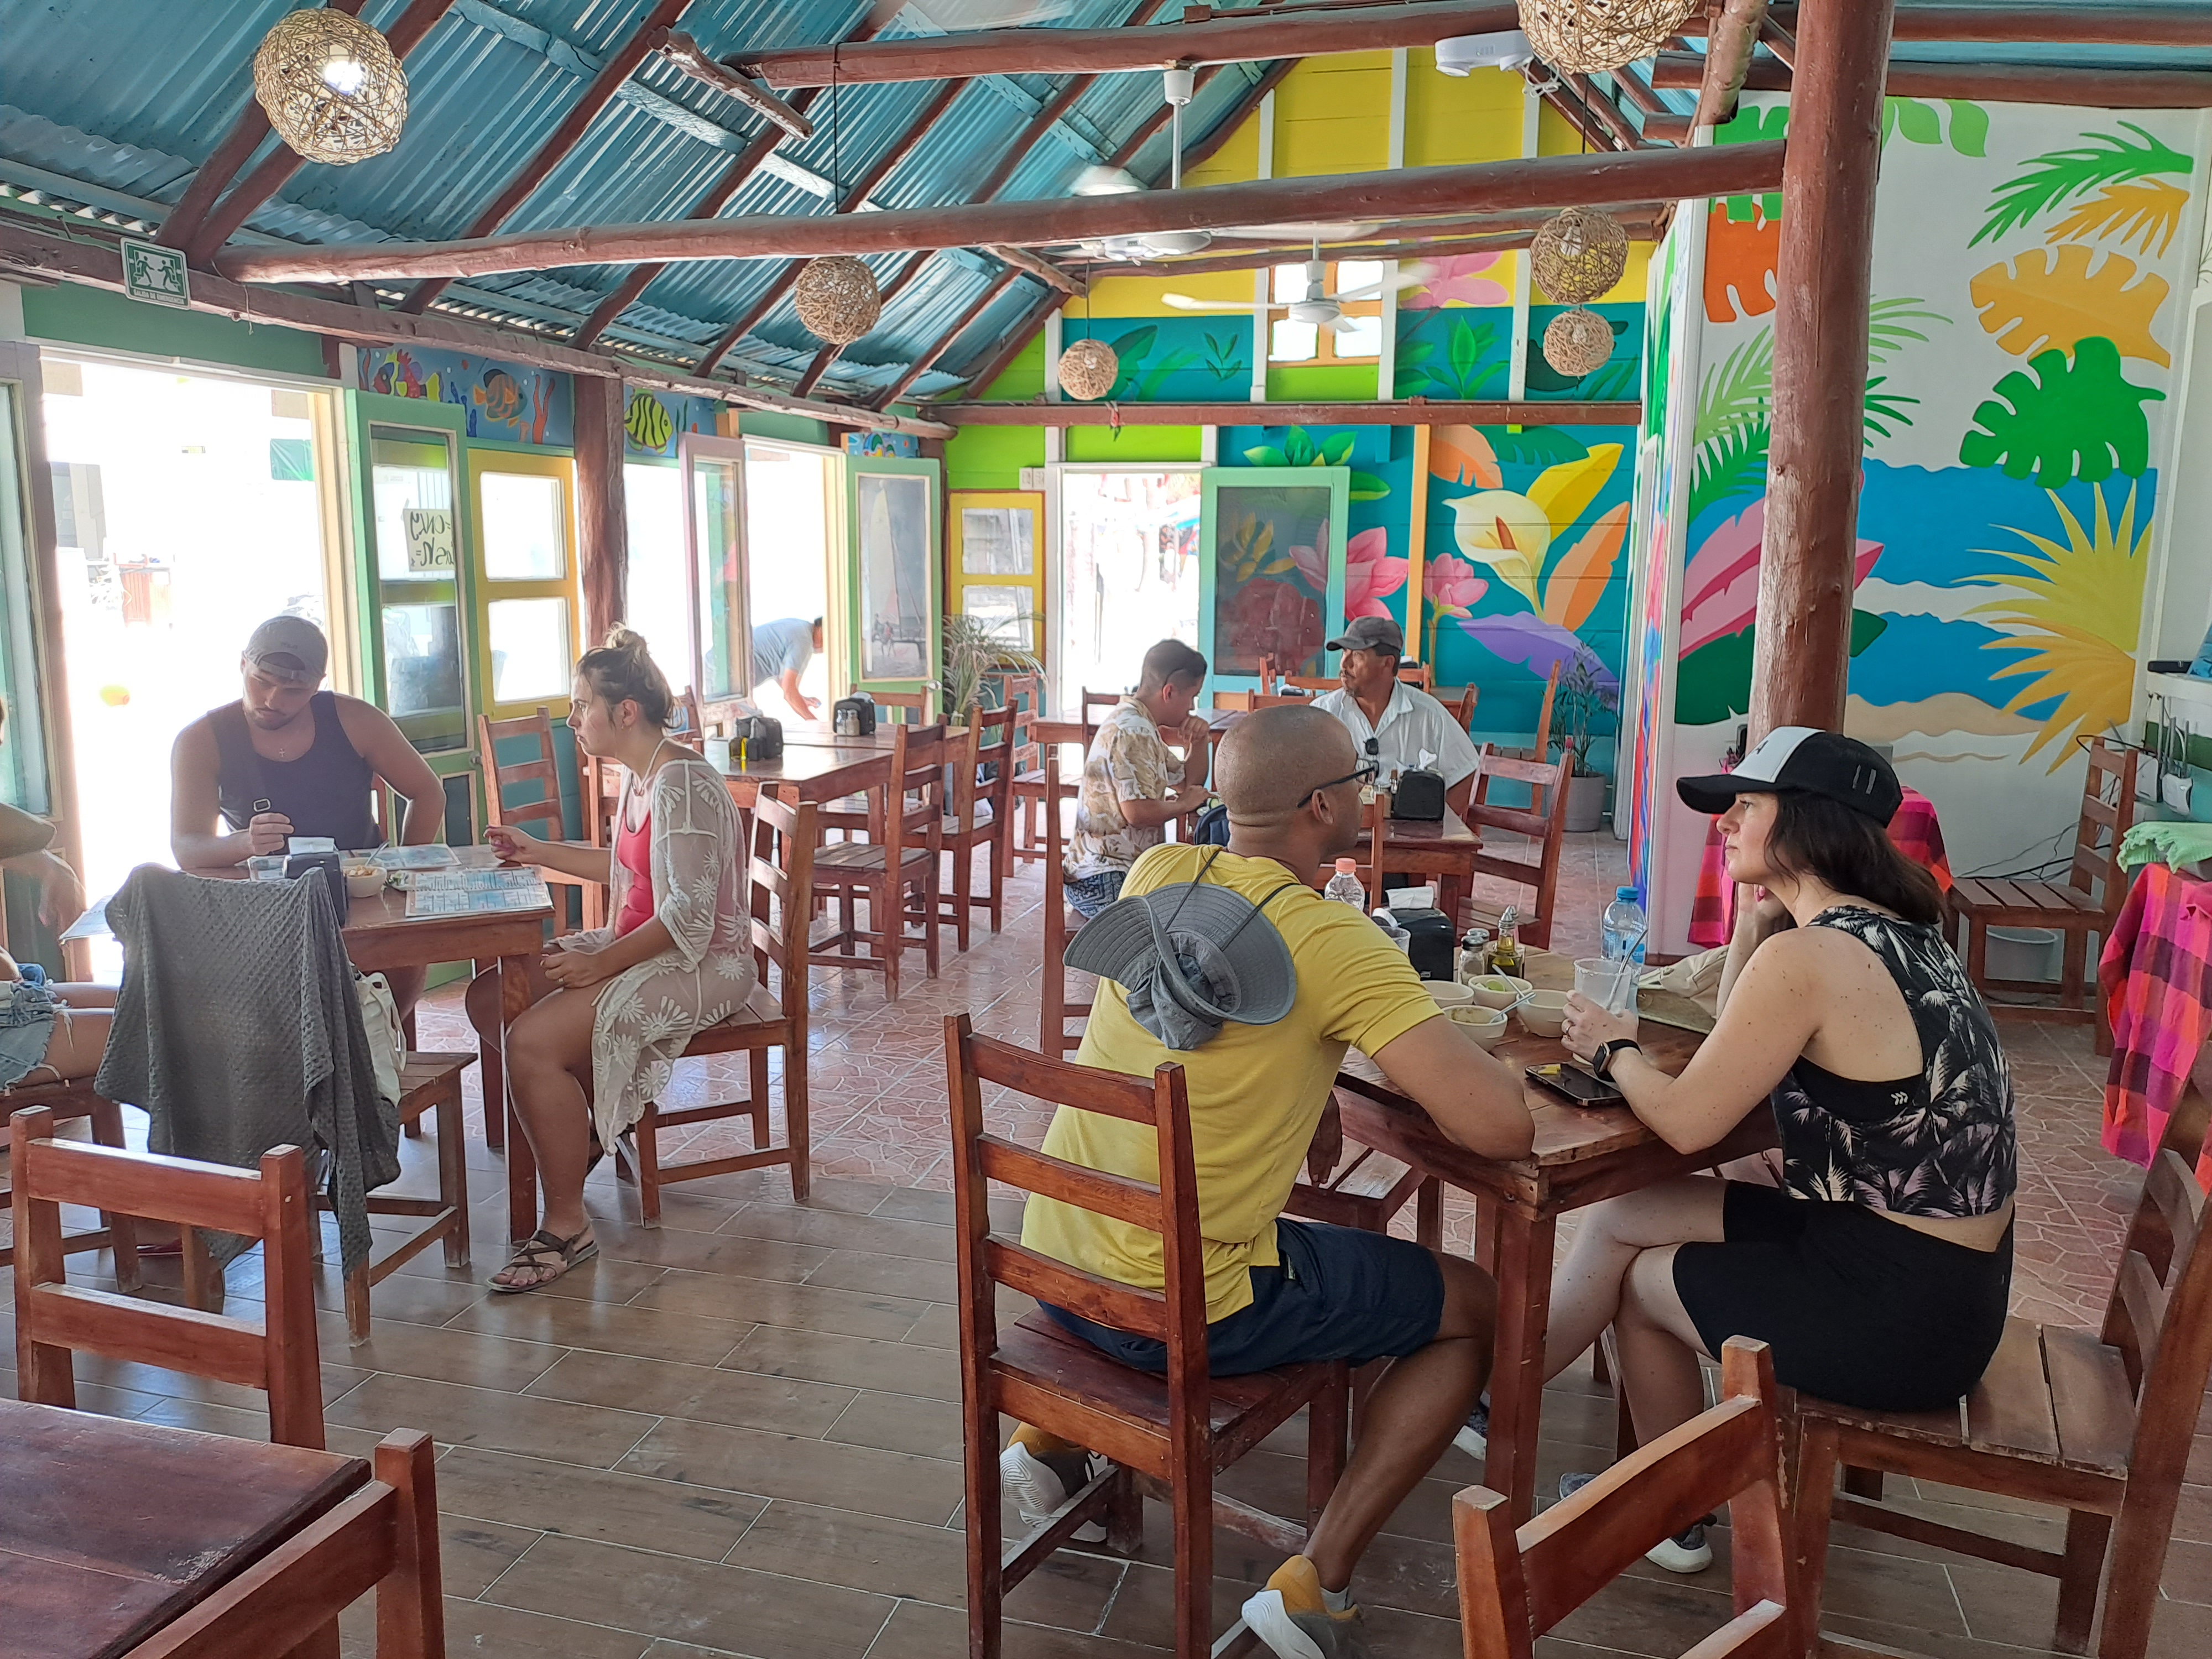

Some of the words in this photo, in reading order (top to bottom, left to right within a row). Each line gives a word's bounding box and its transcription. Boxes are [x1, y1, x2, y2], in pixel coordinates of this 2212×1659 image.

[133, 289, 150, 298] SALIDA
[150, 291, 156, 300] DE
[156, 293, 185, 305] EMERGENCIA
